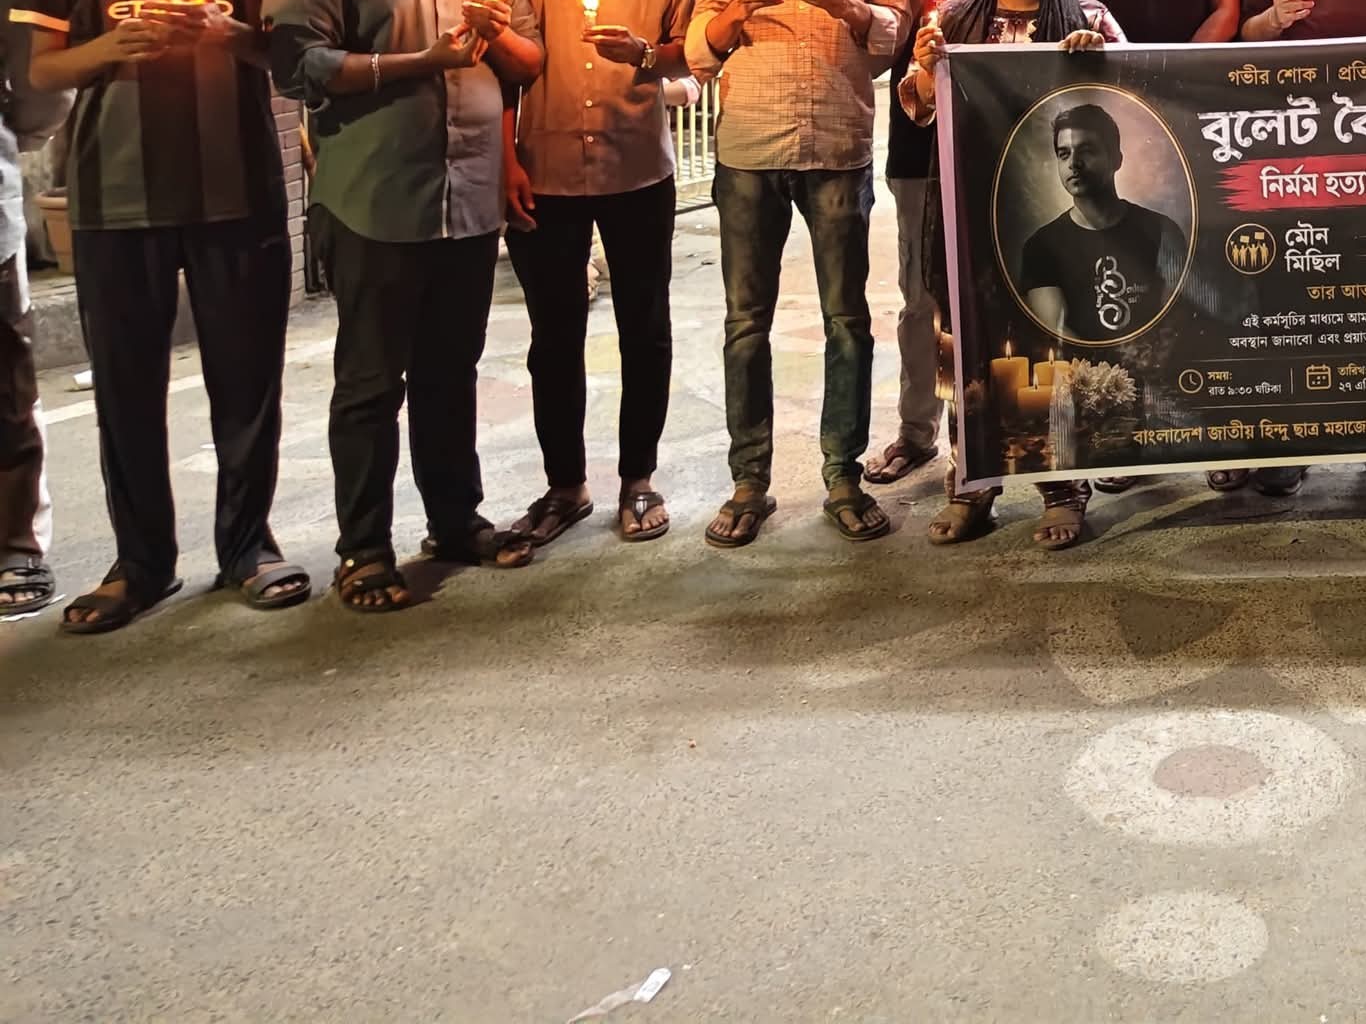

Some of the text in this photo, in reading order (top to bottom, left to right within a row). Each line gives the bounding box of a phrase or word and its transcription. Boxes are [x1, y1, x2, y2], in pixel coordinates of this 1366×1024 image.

[1228, 64, 1318, 86] গভীর শোক
[1197, 94, 1320, 163] বুলেট
[1259, 164, 1320, 199] নির্মম
[1285, 221, 1330, 247] মৌন
[1284, 248, 1342, 273] মিছিল
[1306, 284, 1335, 301] তার
[1242, 313, 1260, 328] এই
[1262, 311, 1306, 329] কর্মসূচির
[1309, 312, 1344, 326] মাধ্যমে
[1228, 335, 1268, 350] অবস্থান
[1271, 333, 1313, 347] জানাবো
[1317, 332, 1341, 345] এবং
[1208, 385, 1226, 397] রাত
[1254, 381, 1282, 395] ঘটিকা
[1338, 381, 1352, 393] ২৭
[1131, 426, 1203, 446] বাংলাদেশ
[1207, 419, 1255, 442] জাতীয়
[1259, 418, 1289, 441] হিন্দু
[1292, 420, 1320, 437] ছাত্র
